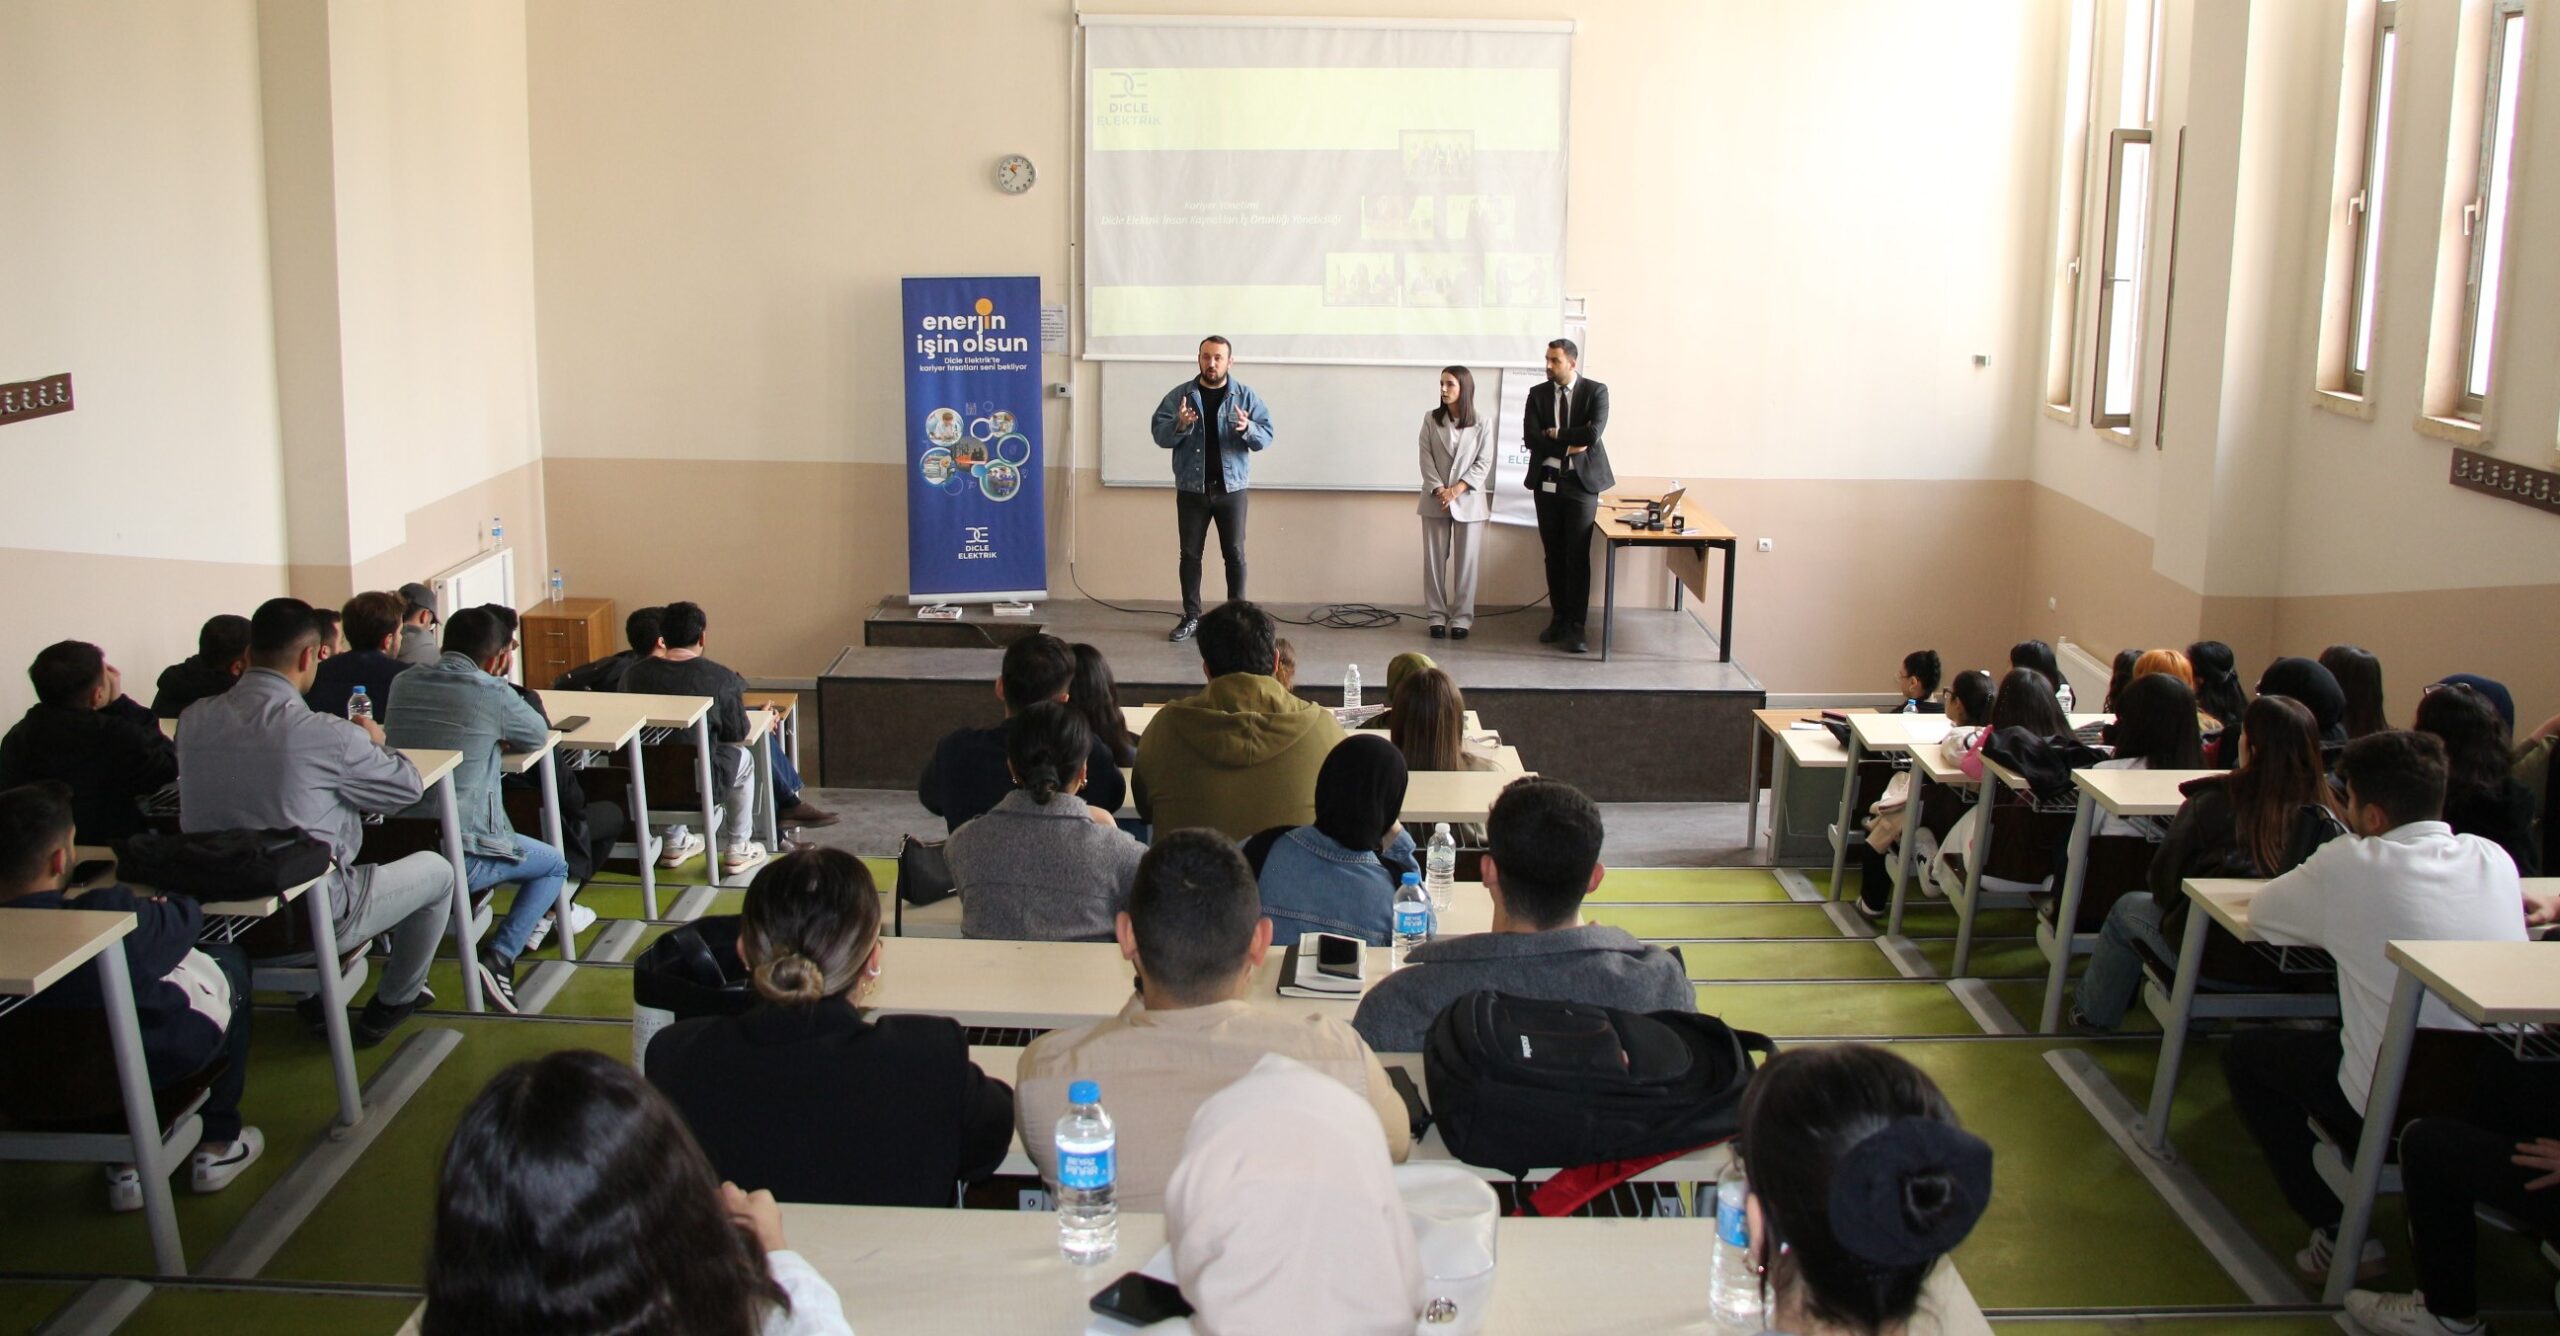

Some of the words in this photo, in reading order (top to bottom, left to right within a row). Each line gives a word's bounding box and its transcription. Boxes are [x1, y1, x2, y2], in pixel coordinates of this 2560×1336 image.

[917, 334, 959, 360] işin
[963, 334, 1028, 353] olsun
[944, 357, 963, 365] Dicle
[920, 364, 946, 374] kariyer
[981, 363, 996, 371] seni
[998, 362, 1028, 372] bekliyor
